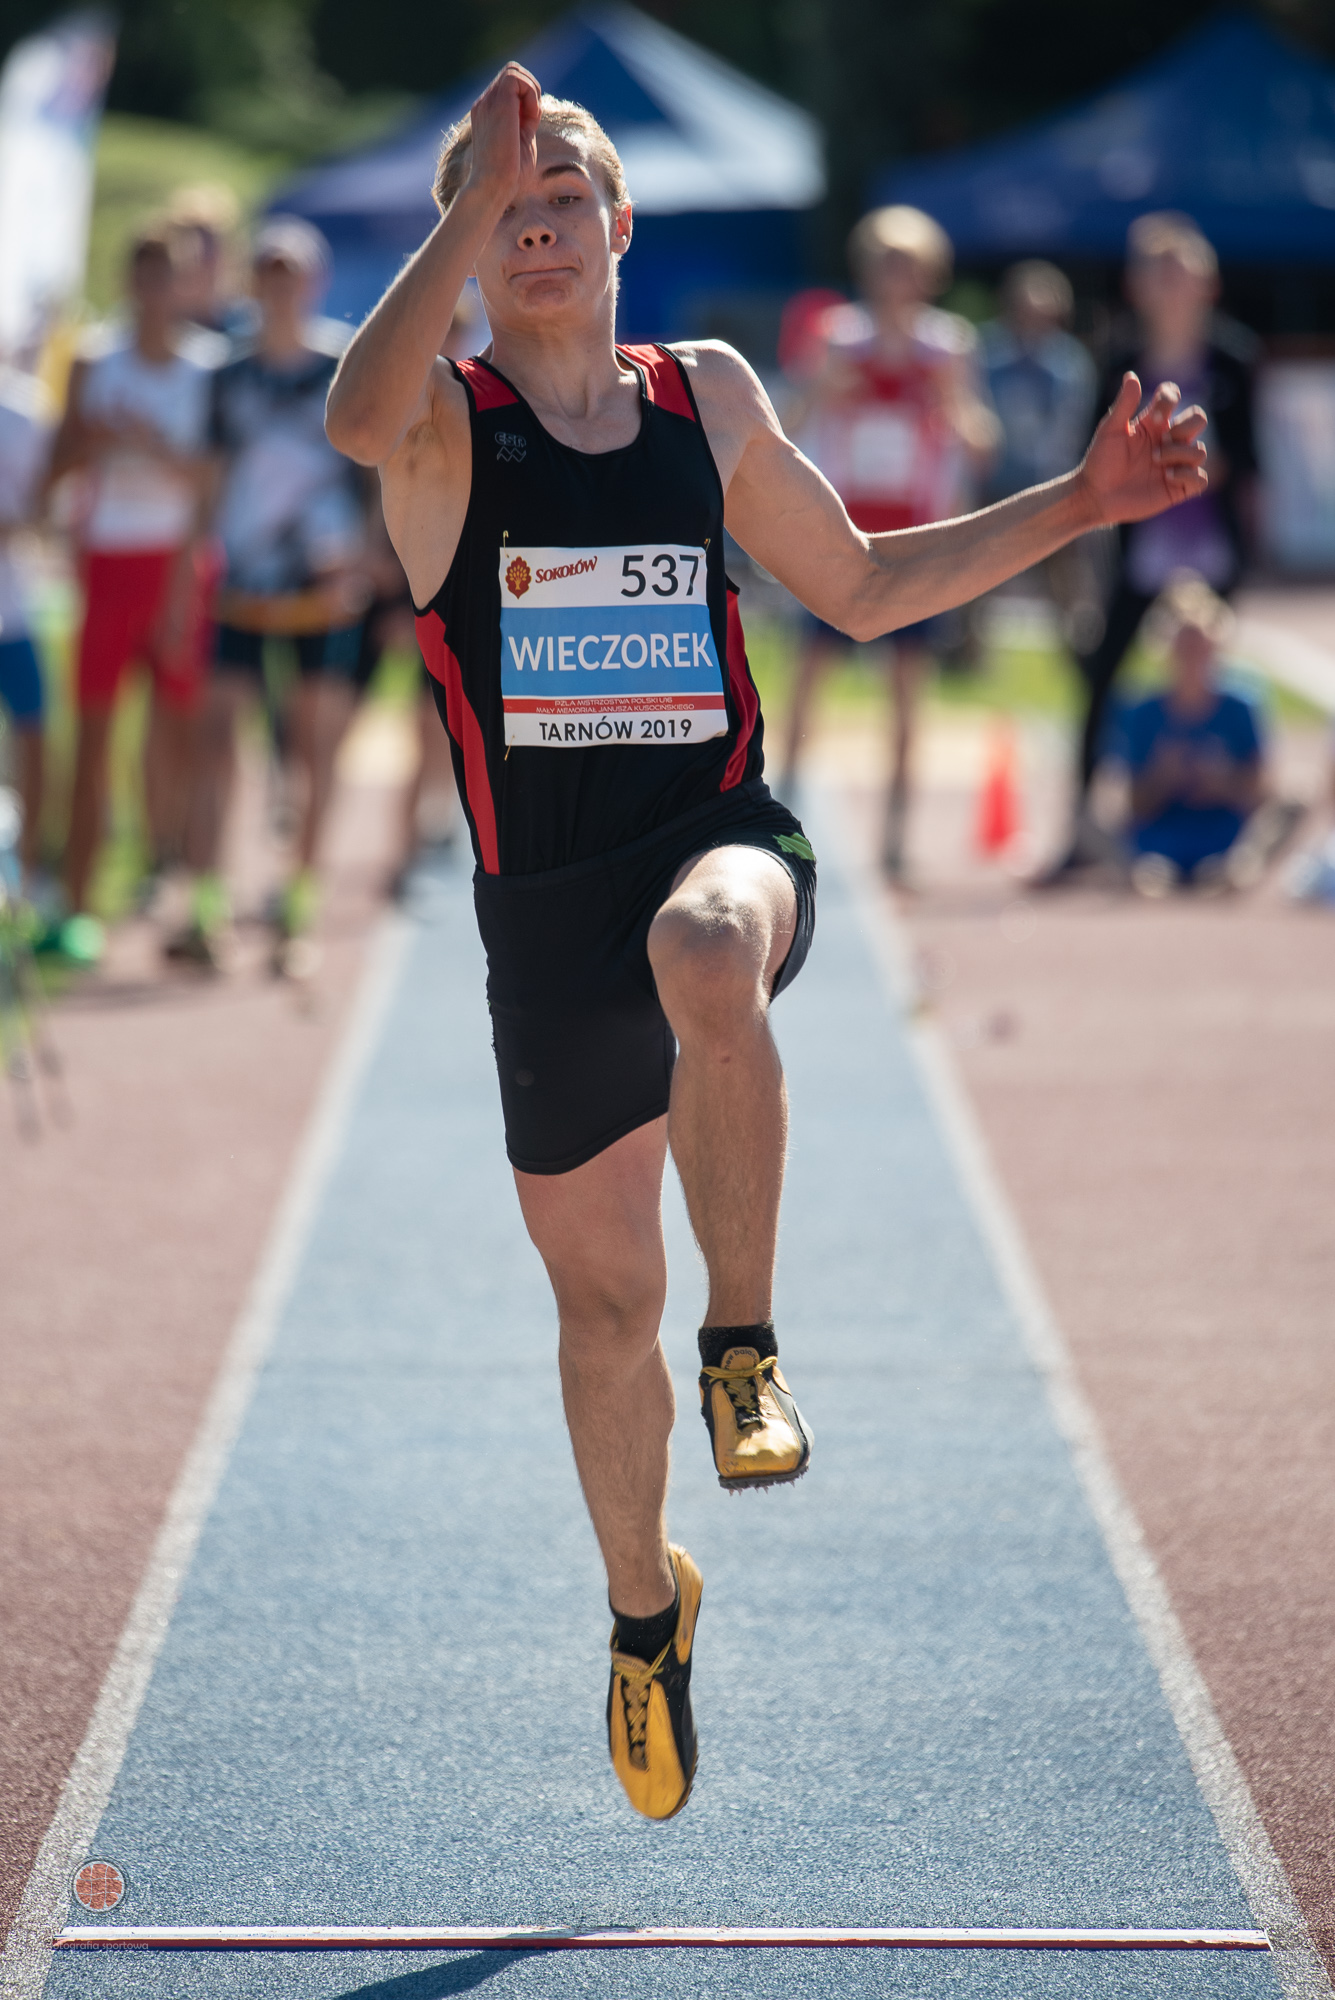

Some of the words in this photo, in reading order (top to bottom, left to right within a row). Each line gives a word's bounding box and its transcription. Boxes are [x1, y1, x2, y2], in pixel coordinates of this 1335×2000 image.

[535, 555, 598, 584] SOKOŁÓW
[620, 553, 700, 598] 537
[507, 632, 714, 672] WIECZOREK
[598, 705, 633, 713] JANUSZA
[538, 716, 634, 742] TARNÓW
[640, 718, 693, 740] 2019
